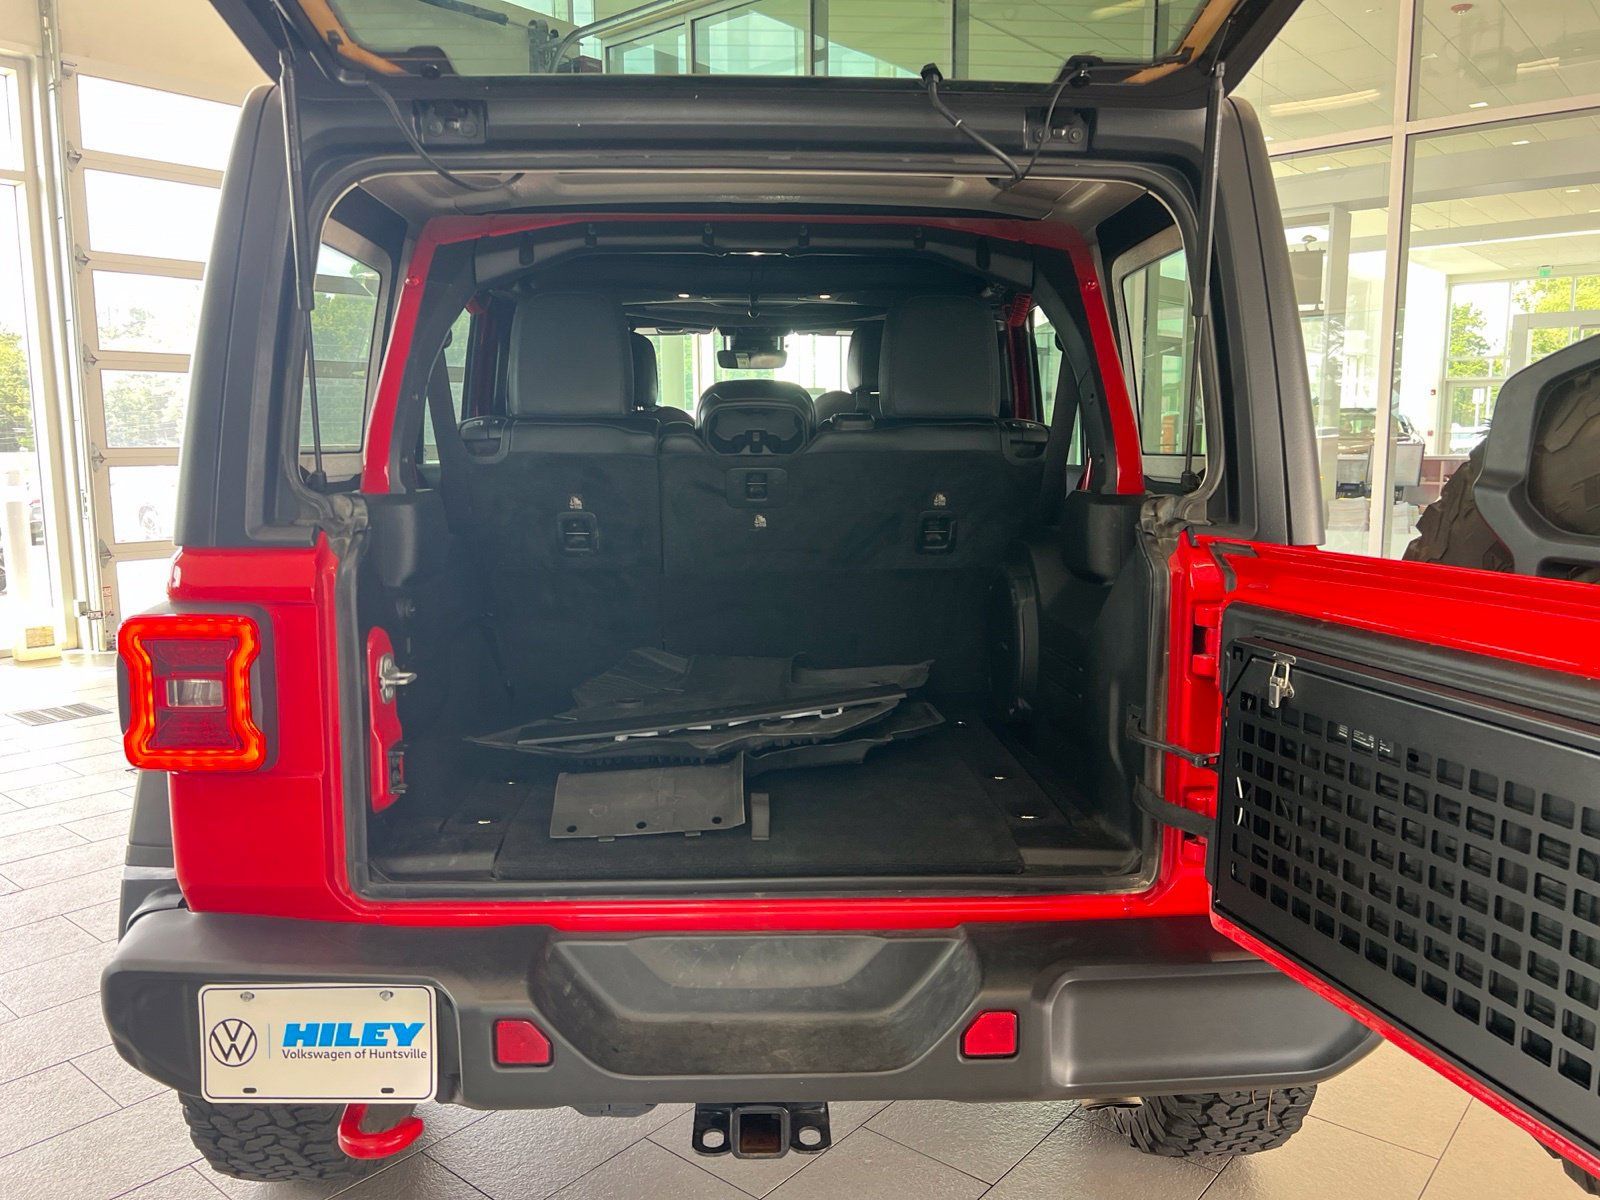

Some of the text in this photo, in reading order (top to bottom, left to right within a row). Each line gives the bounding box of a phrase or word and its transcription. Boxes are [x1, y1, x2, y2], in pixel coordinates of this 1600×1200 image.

[282, 1022, 425, 1047] HILEY
[282, 1048, 427, 1061] Volkswagen of Huntsville
